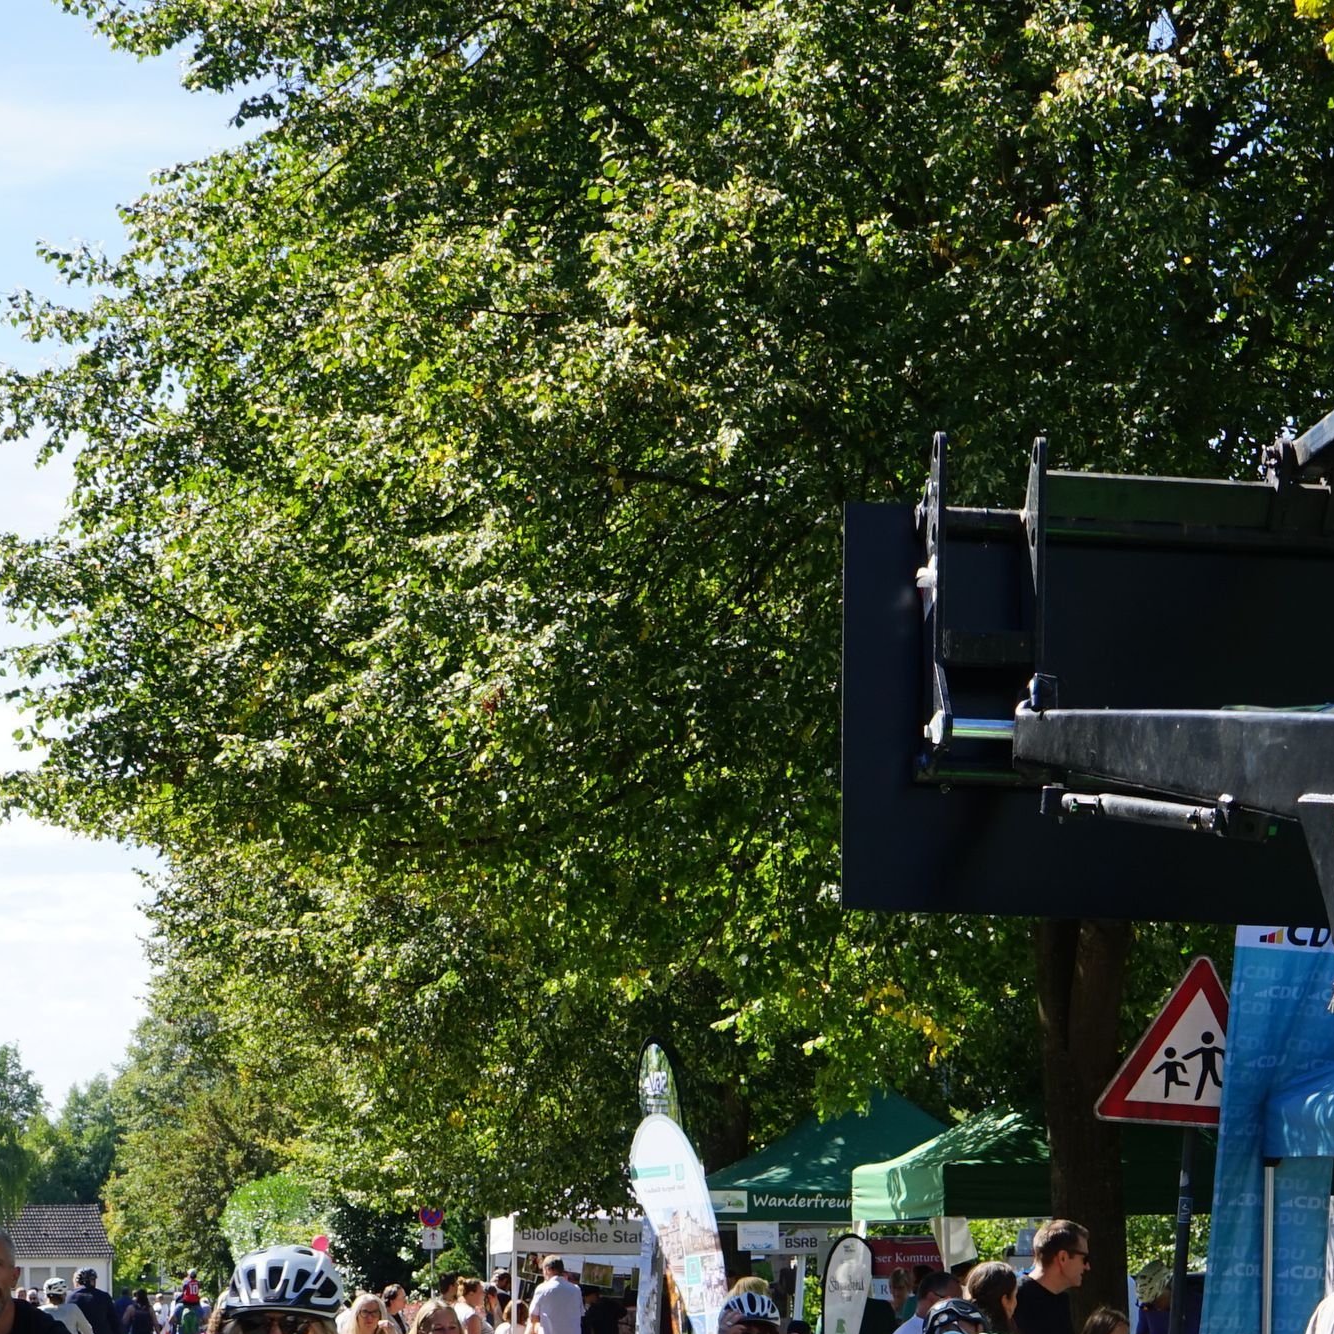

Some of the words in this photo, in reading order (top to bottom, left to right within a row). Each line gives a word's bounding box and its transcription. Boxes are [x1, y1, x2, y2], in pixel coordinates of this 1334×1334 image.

[1269, 985, 1304, 999] CDU
[521, 1228, 608, 1244] Biologische
[784, 1237, 818, 1248] BSRB
